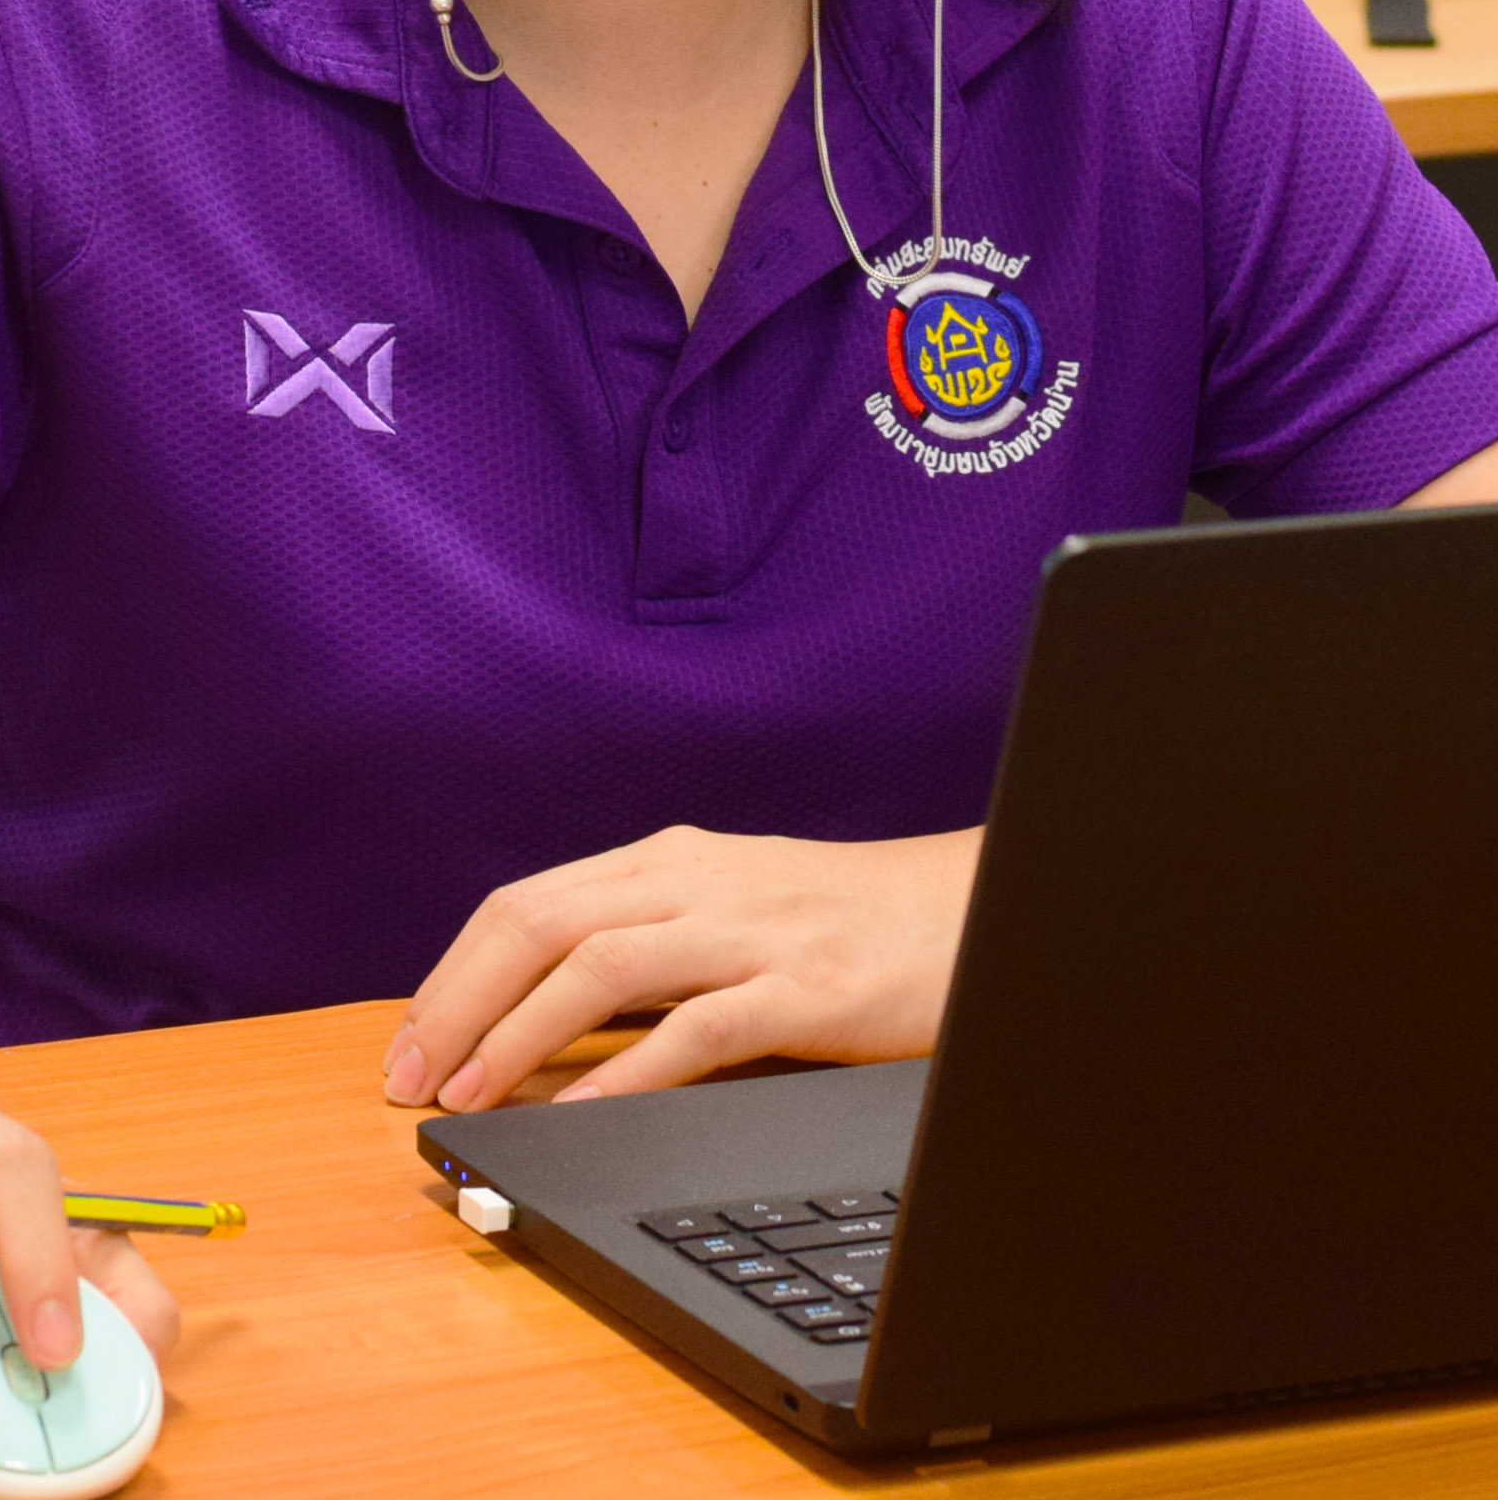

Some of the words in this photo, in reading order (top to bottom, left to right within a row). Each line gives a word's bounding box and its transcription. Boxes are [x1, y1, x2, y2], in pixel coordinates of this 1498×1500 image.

[863, 360, 1080, 478] พัฒนาชุมชนจังหวัดน่าน
